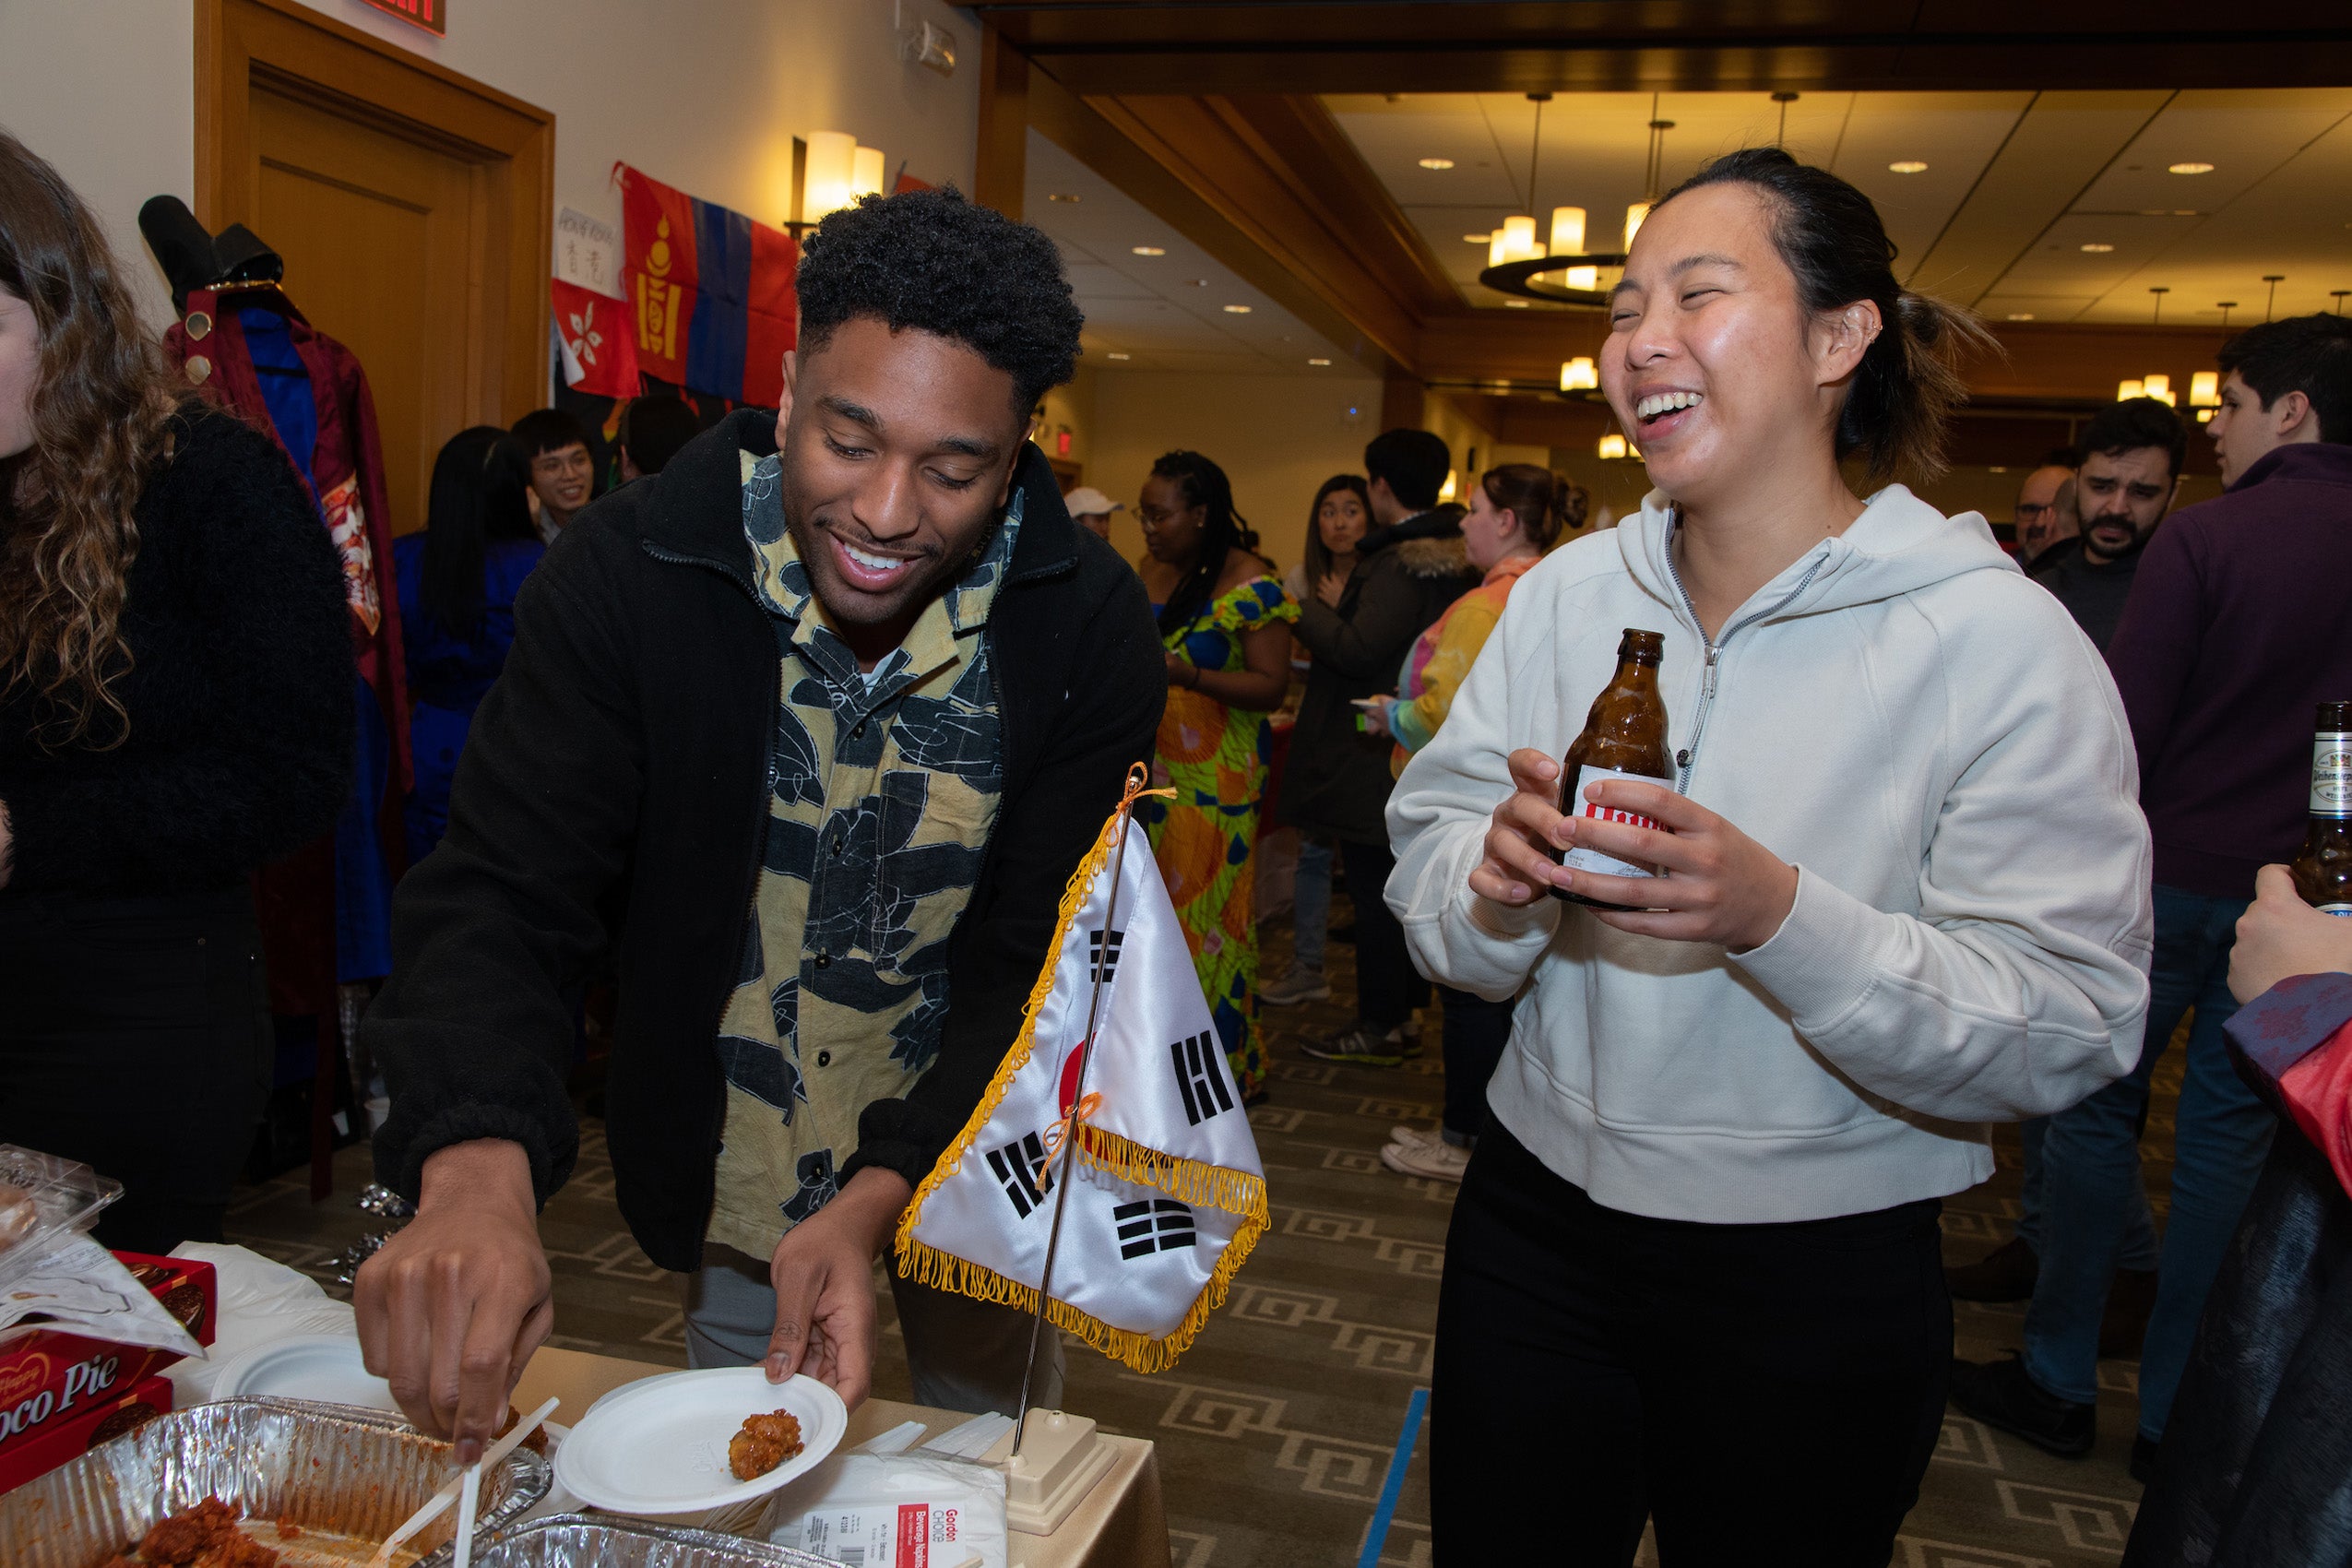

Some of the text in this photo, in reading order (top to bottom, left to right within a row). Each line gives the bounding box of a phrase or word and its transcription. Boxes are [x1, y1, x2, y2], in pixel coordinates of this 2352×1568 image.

[55, 1353, 119, 1413] Pie
[913, 1511, 926, 1543] Beverage
[945, 1508, 958, 1543] Gordon
